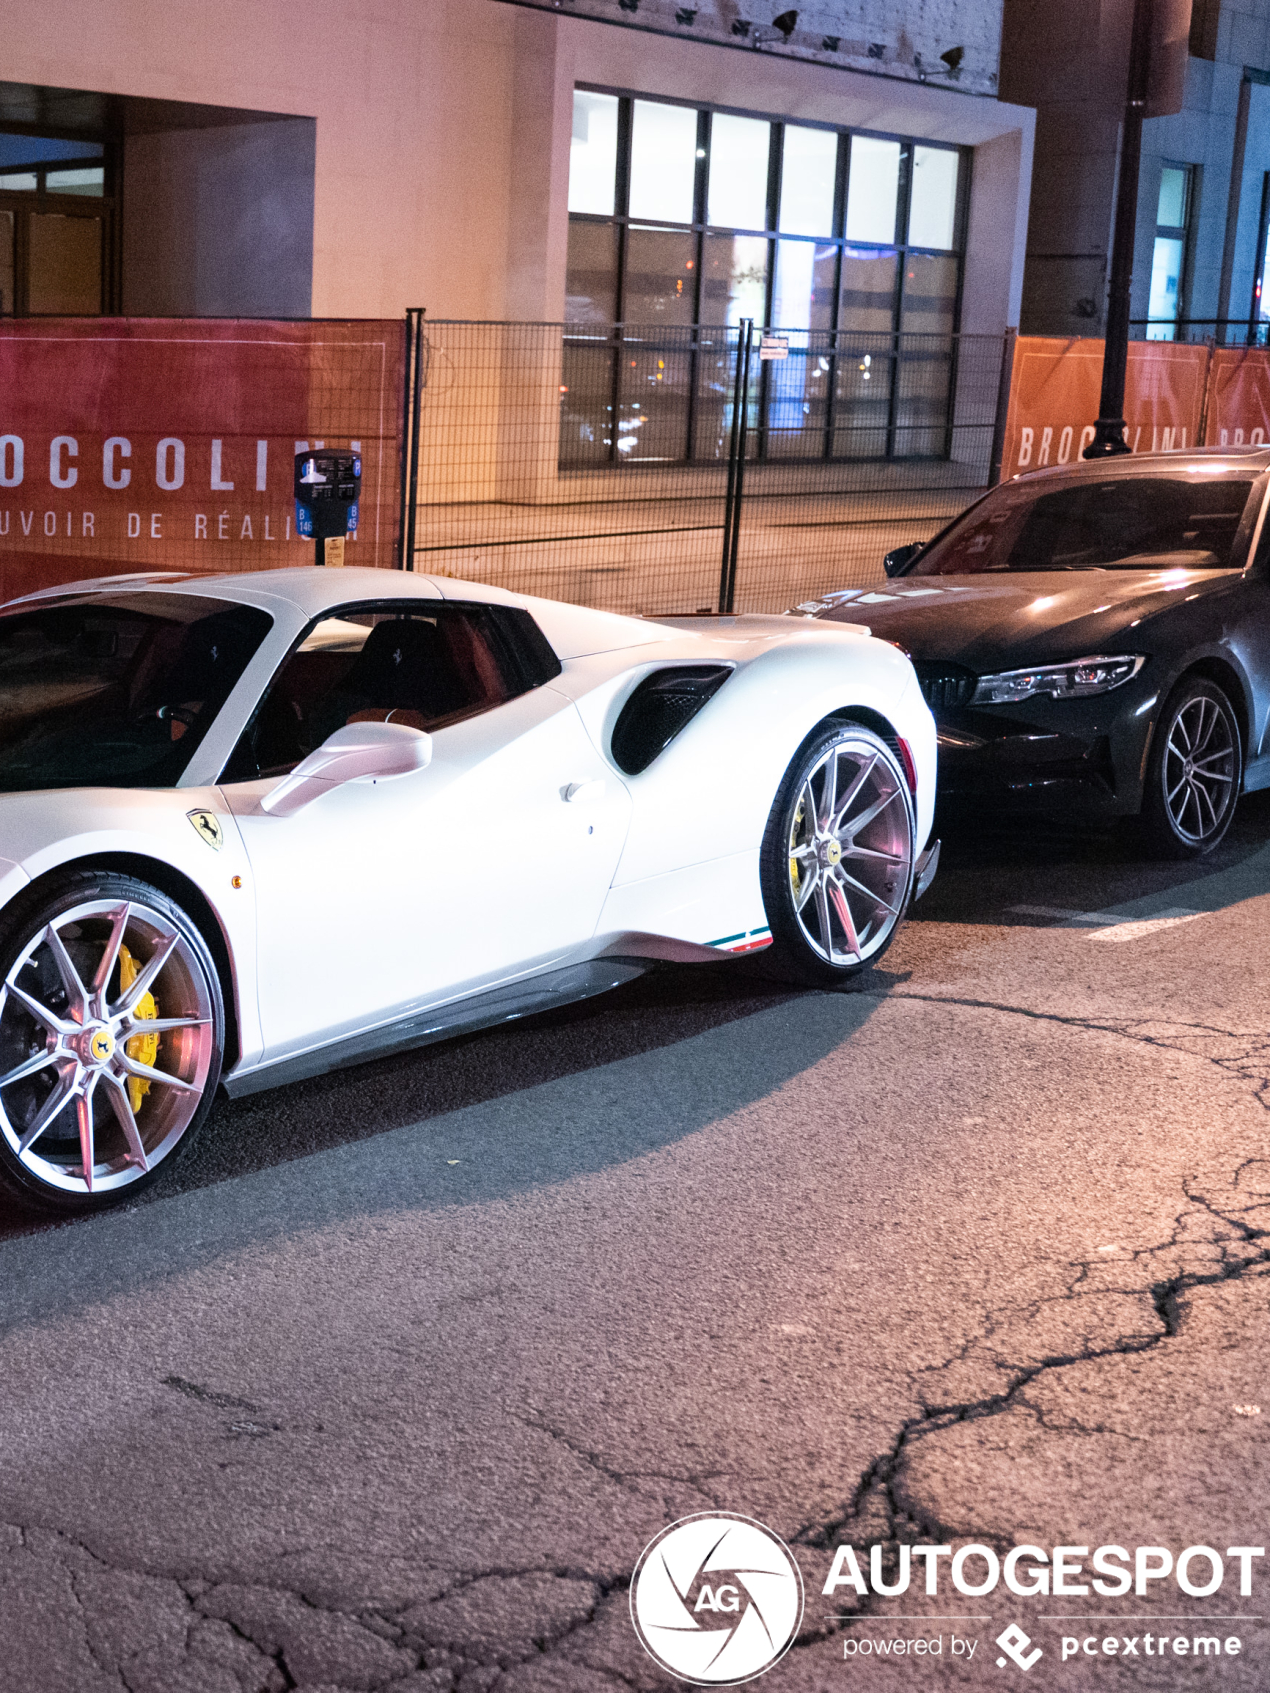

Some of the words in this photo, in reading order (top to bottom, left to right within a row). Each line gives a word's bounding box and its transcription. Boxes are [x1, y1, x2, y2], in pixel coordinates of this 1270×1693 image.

[299, 508, 305, 520] B
[351, 505, 357, 517] B
[128, 513, 162, 538] DE
[195, 510, 358, 541] RÉALI
